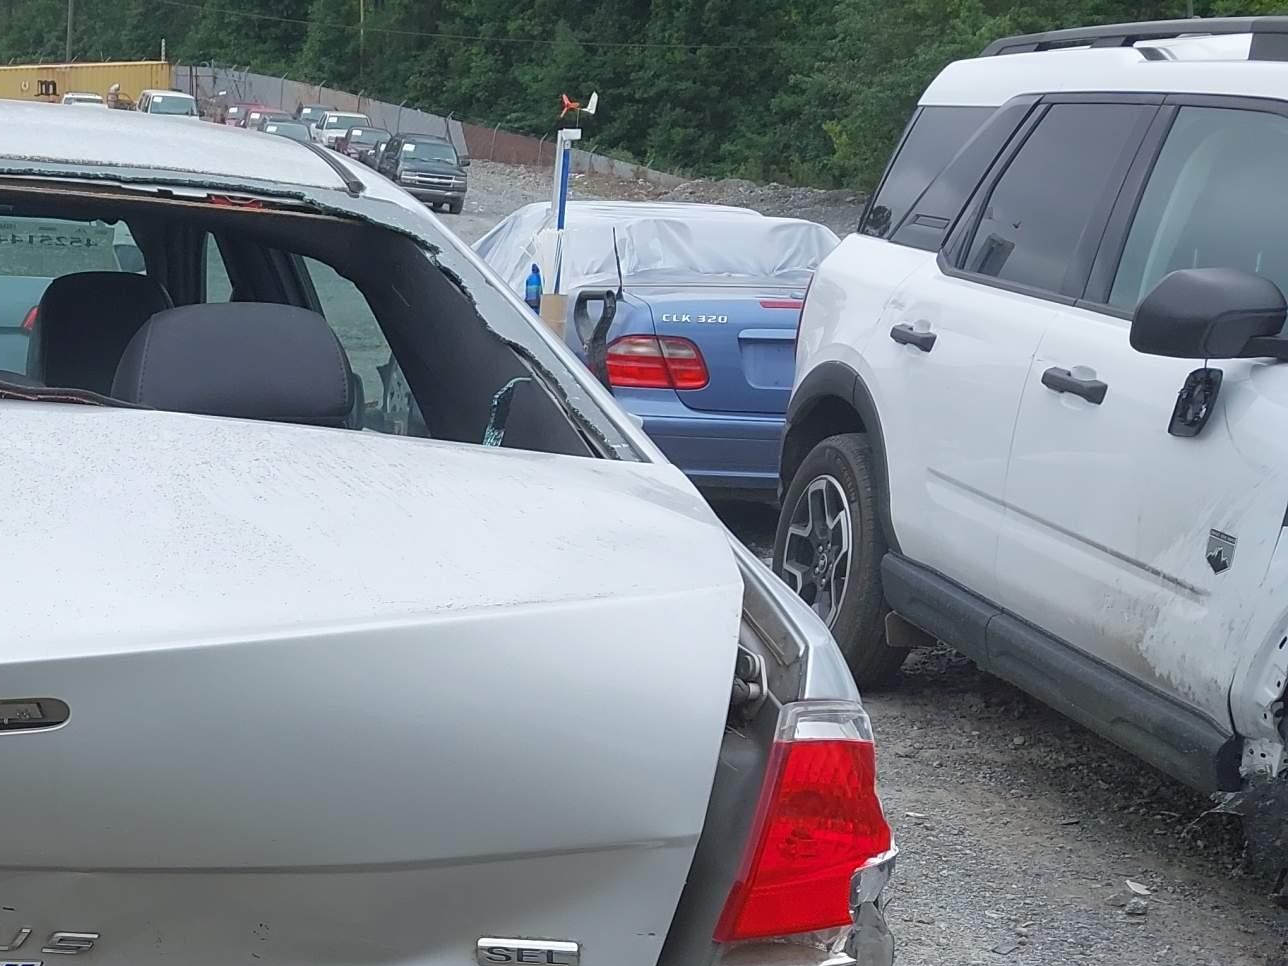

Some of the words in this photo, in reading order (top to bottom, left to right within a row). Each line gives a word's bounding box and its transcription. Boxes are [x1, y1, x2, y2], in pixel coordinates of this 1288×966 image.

[662, 313, 692, 323] CLK
[696, 314, 728, 324] 320
[486, 946, 570, 965] SEL
